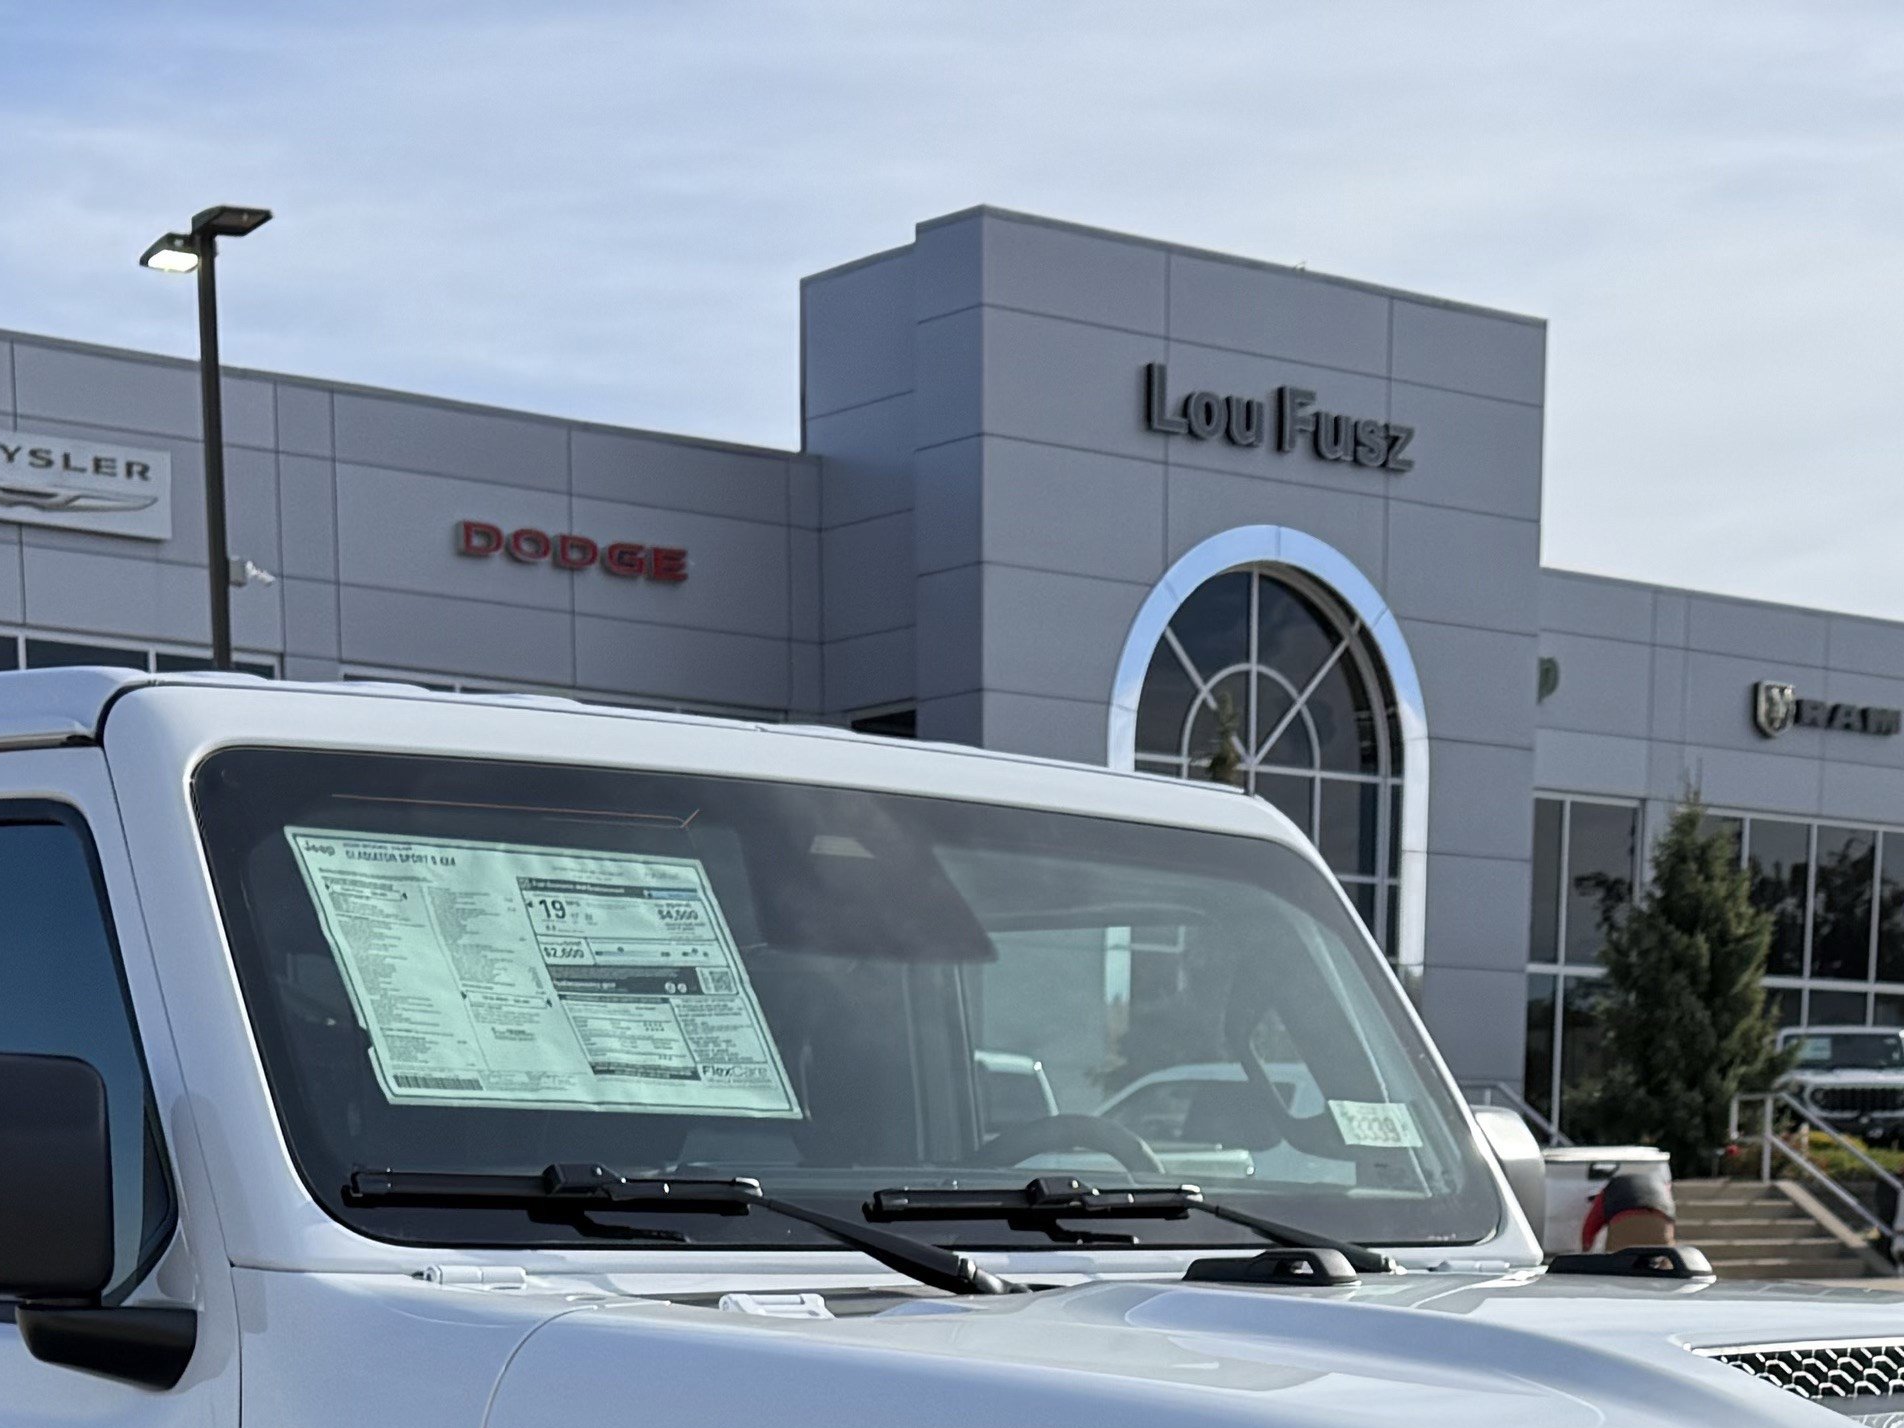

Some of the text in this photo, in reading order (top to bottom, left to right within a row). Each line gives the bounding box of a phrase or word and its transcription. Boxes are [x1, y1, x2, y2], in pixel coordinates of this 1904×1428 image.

[1145, 362, 1415, 472] Lou Fusz
[456, 520, 689, 581] DODGE
[1794, 699, 1902, 736] RAM
[539, 899, 567, 919] 19
